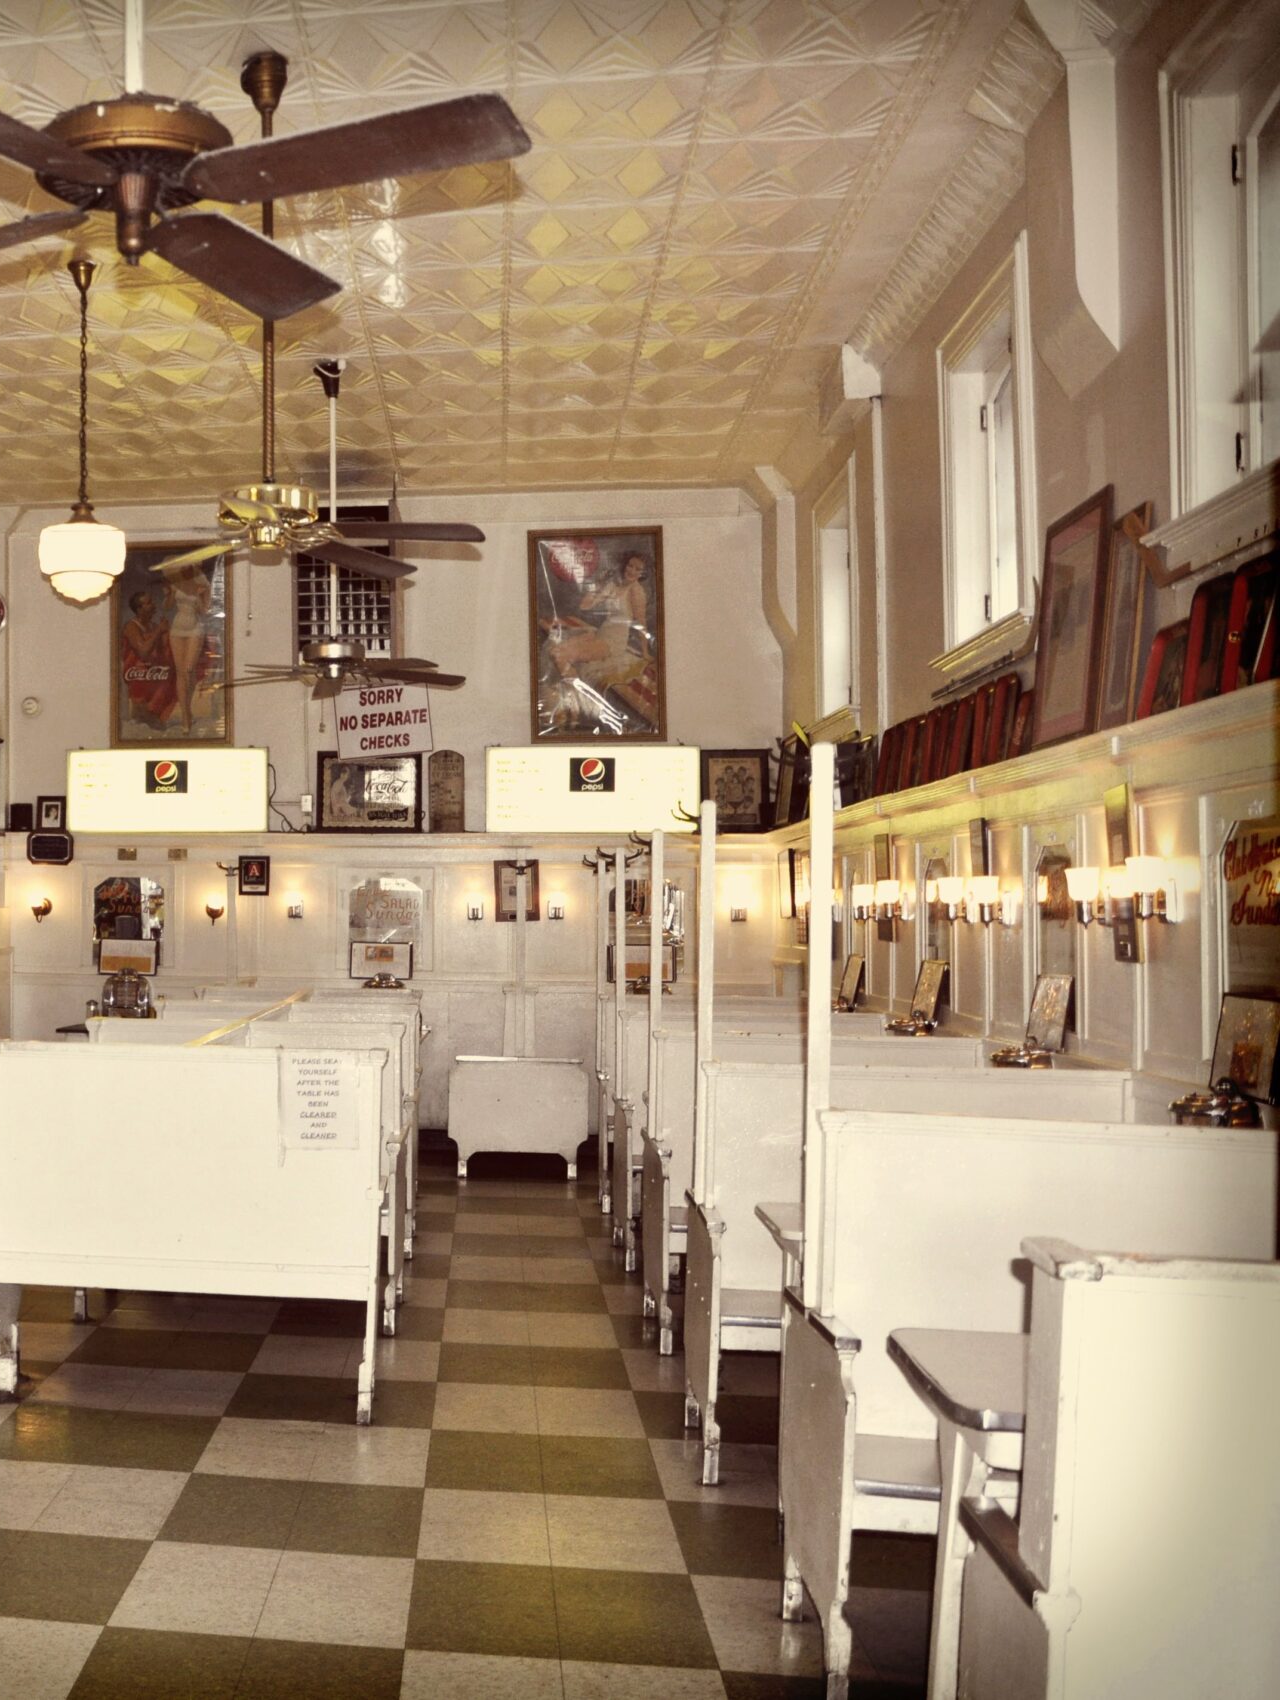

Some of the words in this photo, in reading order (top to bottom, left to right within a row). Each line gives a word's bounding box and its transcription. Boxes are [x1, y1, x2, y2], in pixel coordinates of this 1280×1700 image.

[359, 687, 404, 707] SORRY
[339, 715, 358, 731] NO
[361, 708, 428, 729] SEPARATE
[360, 733, 410, 750] CHECKS
[155, 785, 177, 793] pepsi
[581, 783, 604, 791] pepsi
